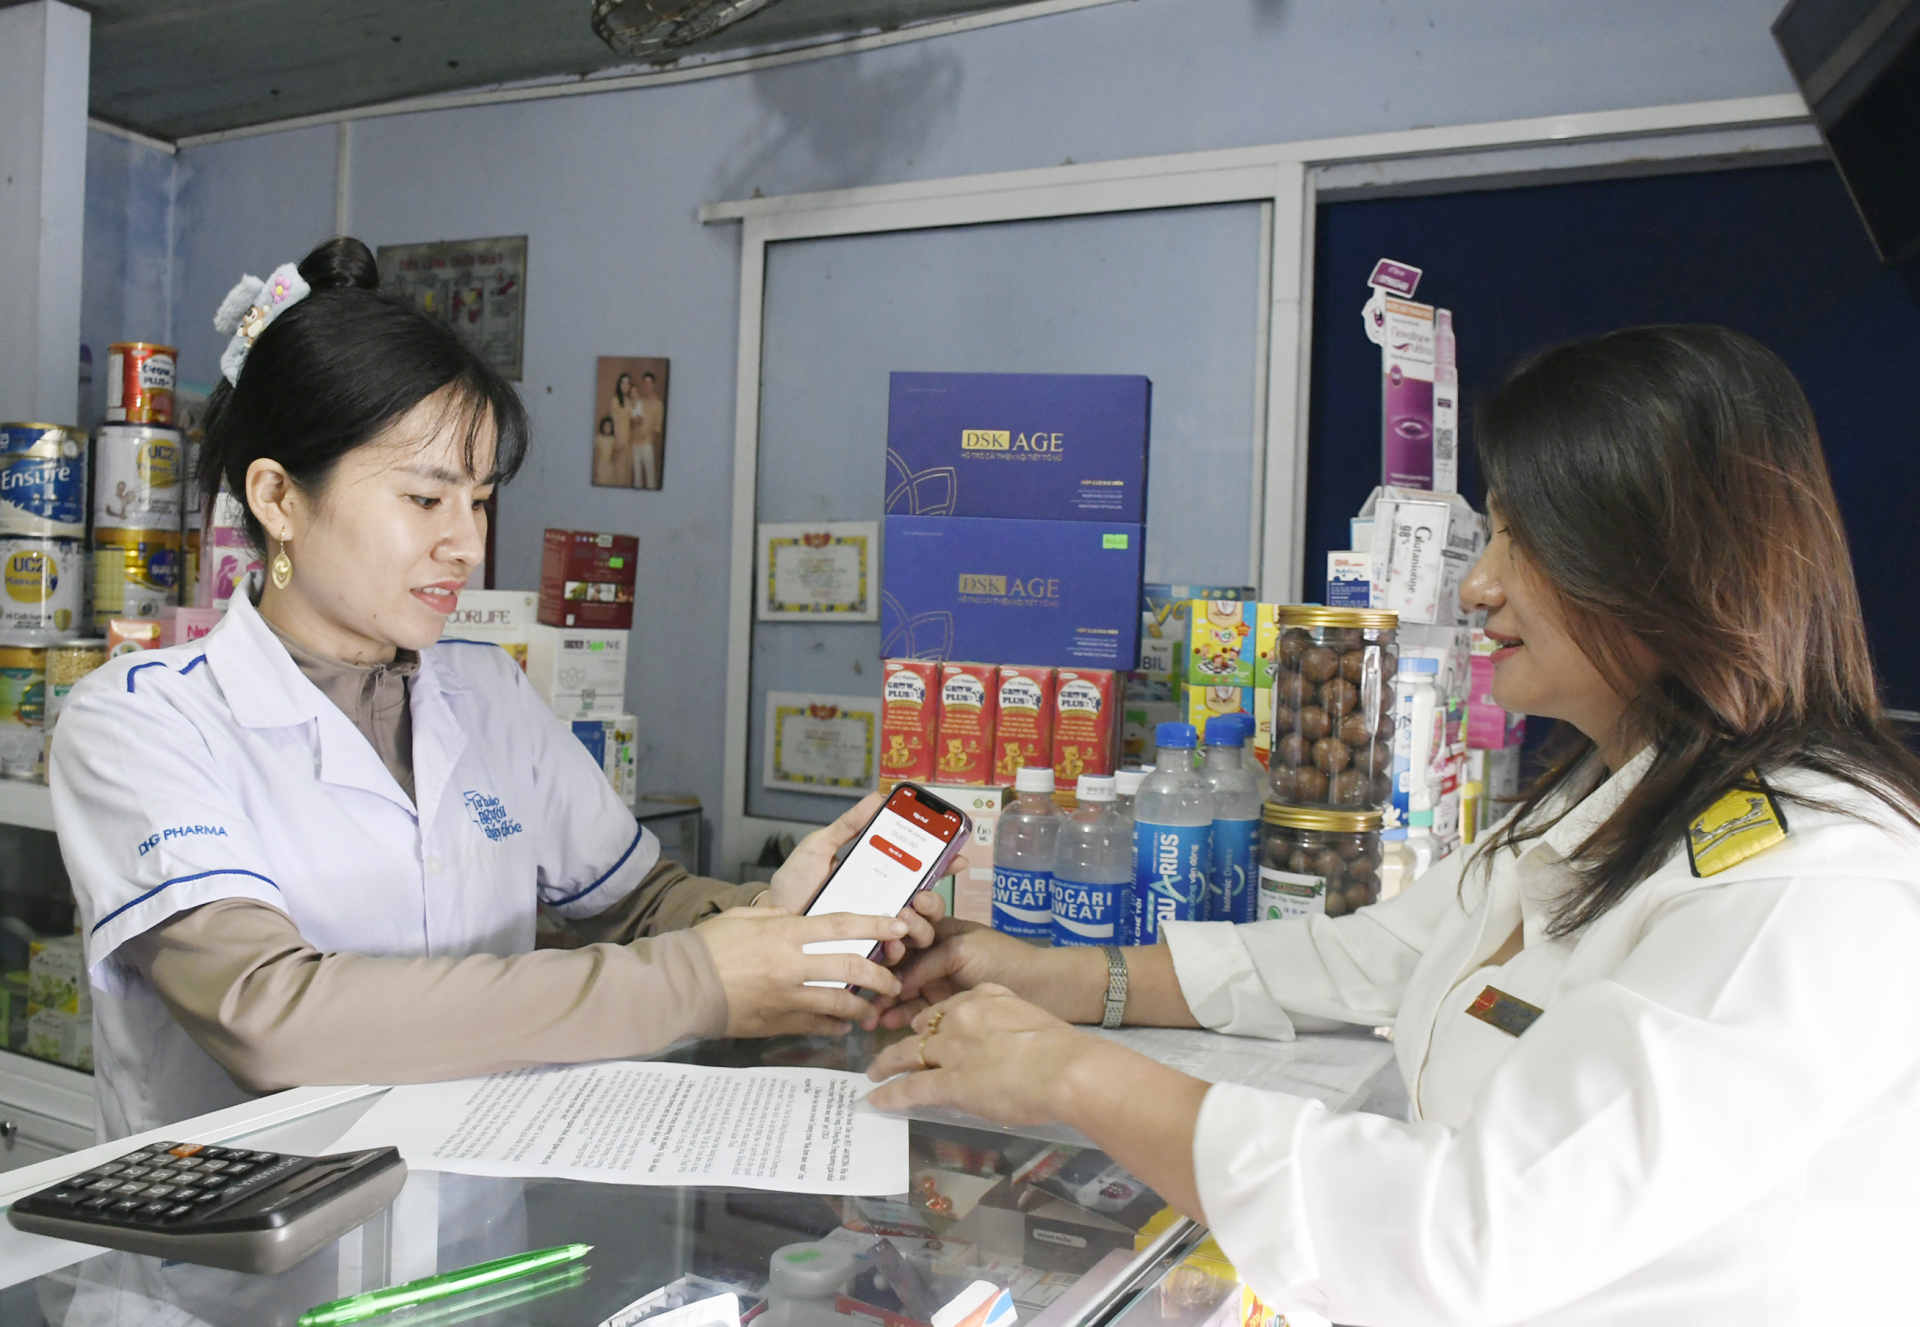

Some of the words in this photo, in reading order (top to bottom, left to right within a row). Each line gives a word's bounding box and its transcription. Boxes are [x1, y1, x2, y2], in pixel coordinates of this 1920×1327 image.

[966, 432, 1004, 448] DSK
[1012, 432, 1064, 452] AGE
[963, 576, 1001, 593] DSK
[1009, 577, 1060, 598] AGE
[138, 833, 161, 857] DHG
[163, 824, 229, 841] PHARMA
[1149, 833, 1188, 921] QUARIUS
[1222, 879, 1232, 912] Isotonic
[178, 1159, 192, 1167] 4
[96, 1181, 112, 1189] 3
